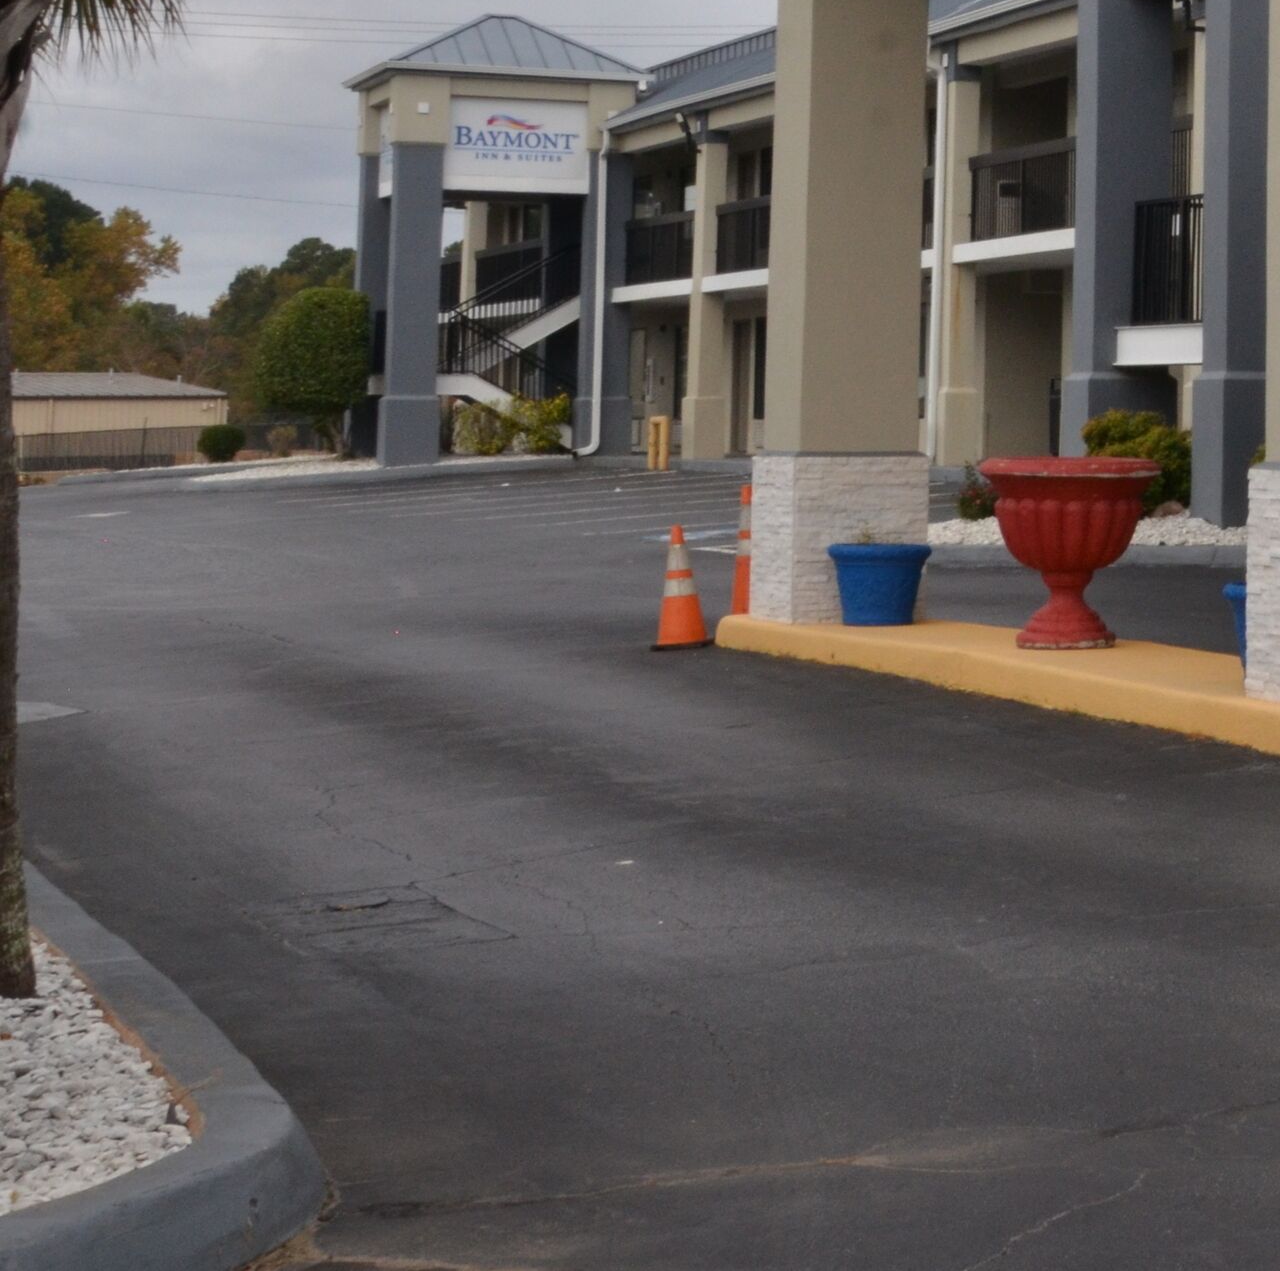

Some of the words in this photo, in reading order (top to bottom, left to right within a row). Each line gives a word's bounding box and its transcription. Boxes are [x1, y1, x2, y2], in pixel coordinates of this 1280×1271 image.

[454, 126, 575, 150] BAYMONT
[475, 152, 498, 160] INN
[503, 153, 511, 161] &
[517, 154, 562, 162] SUITES
